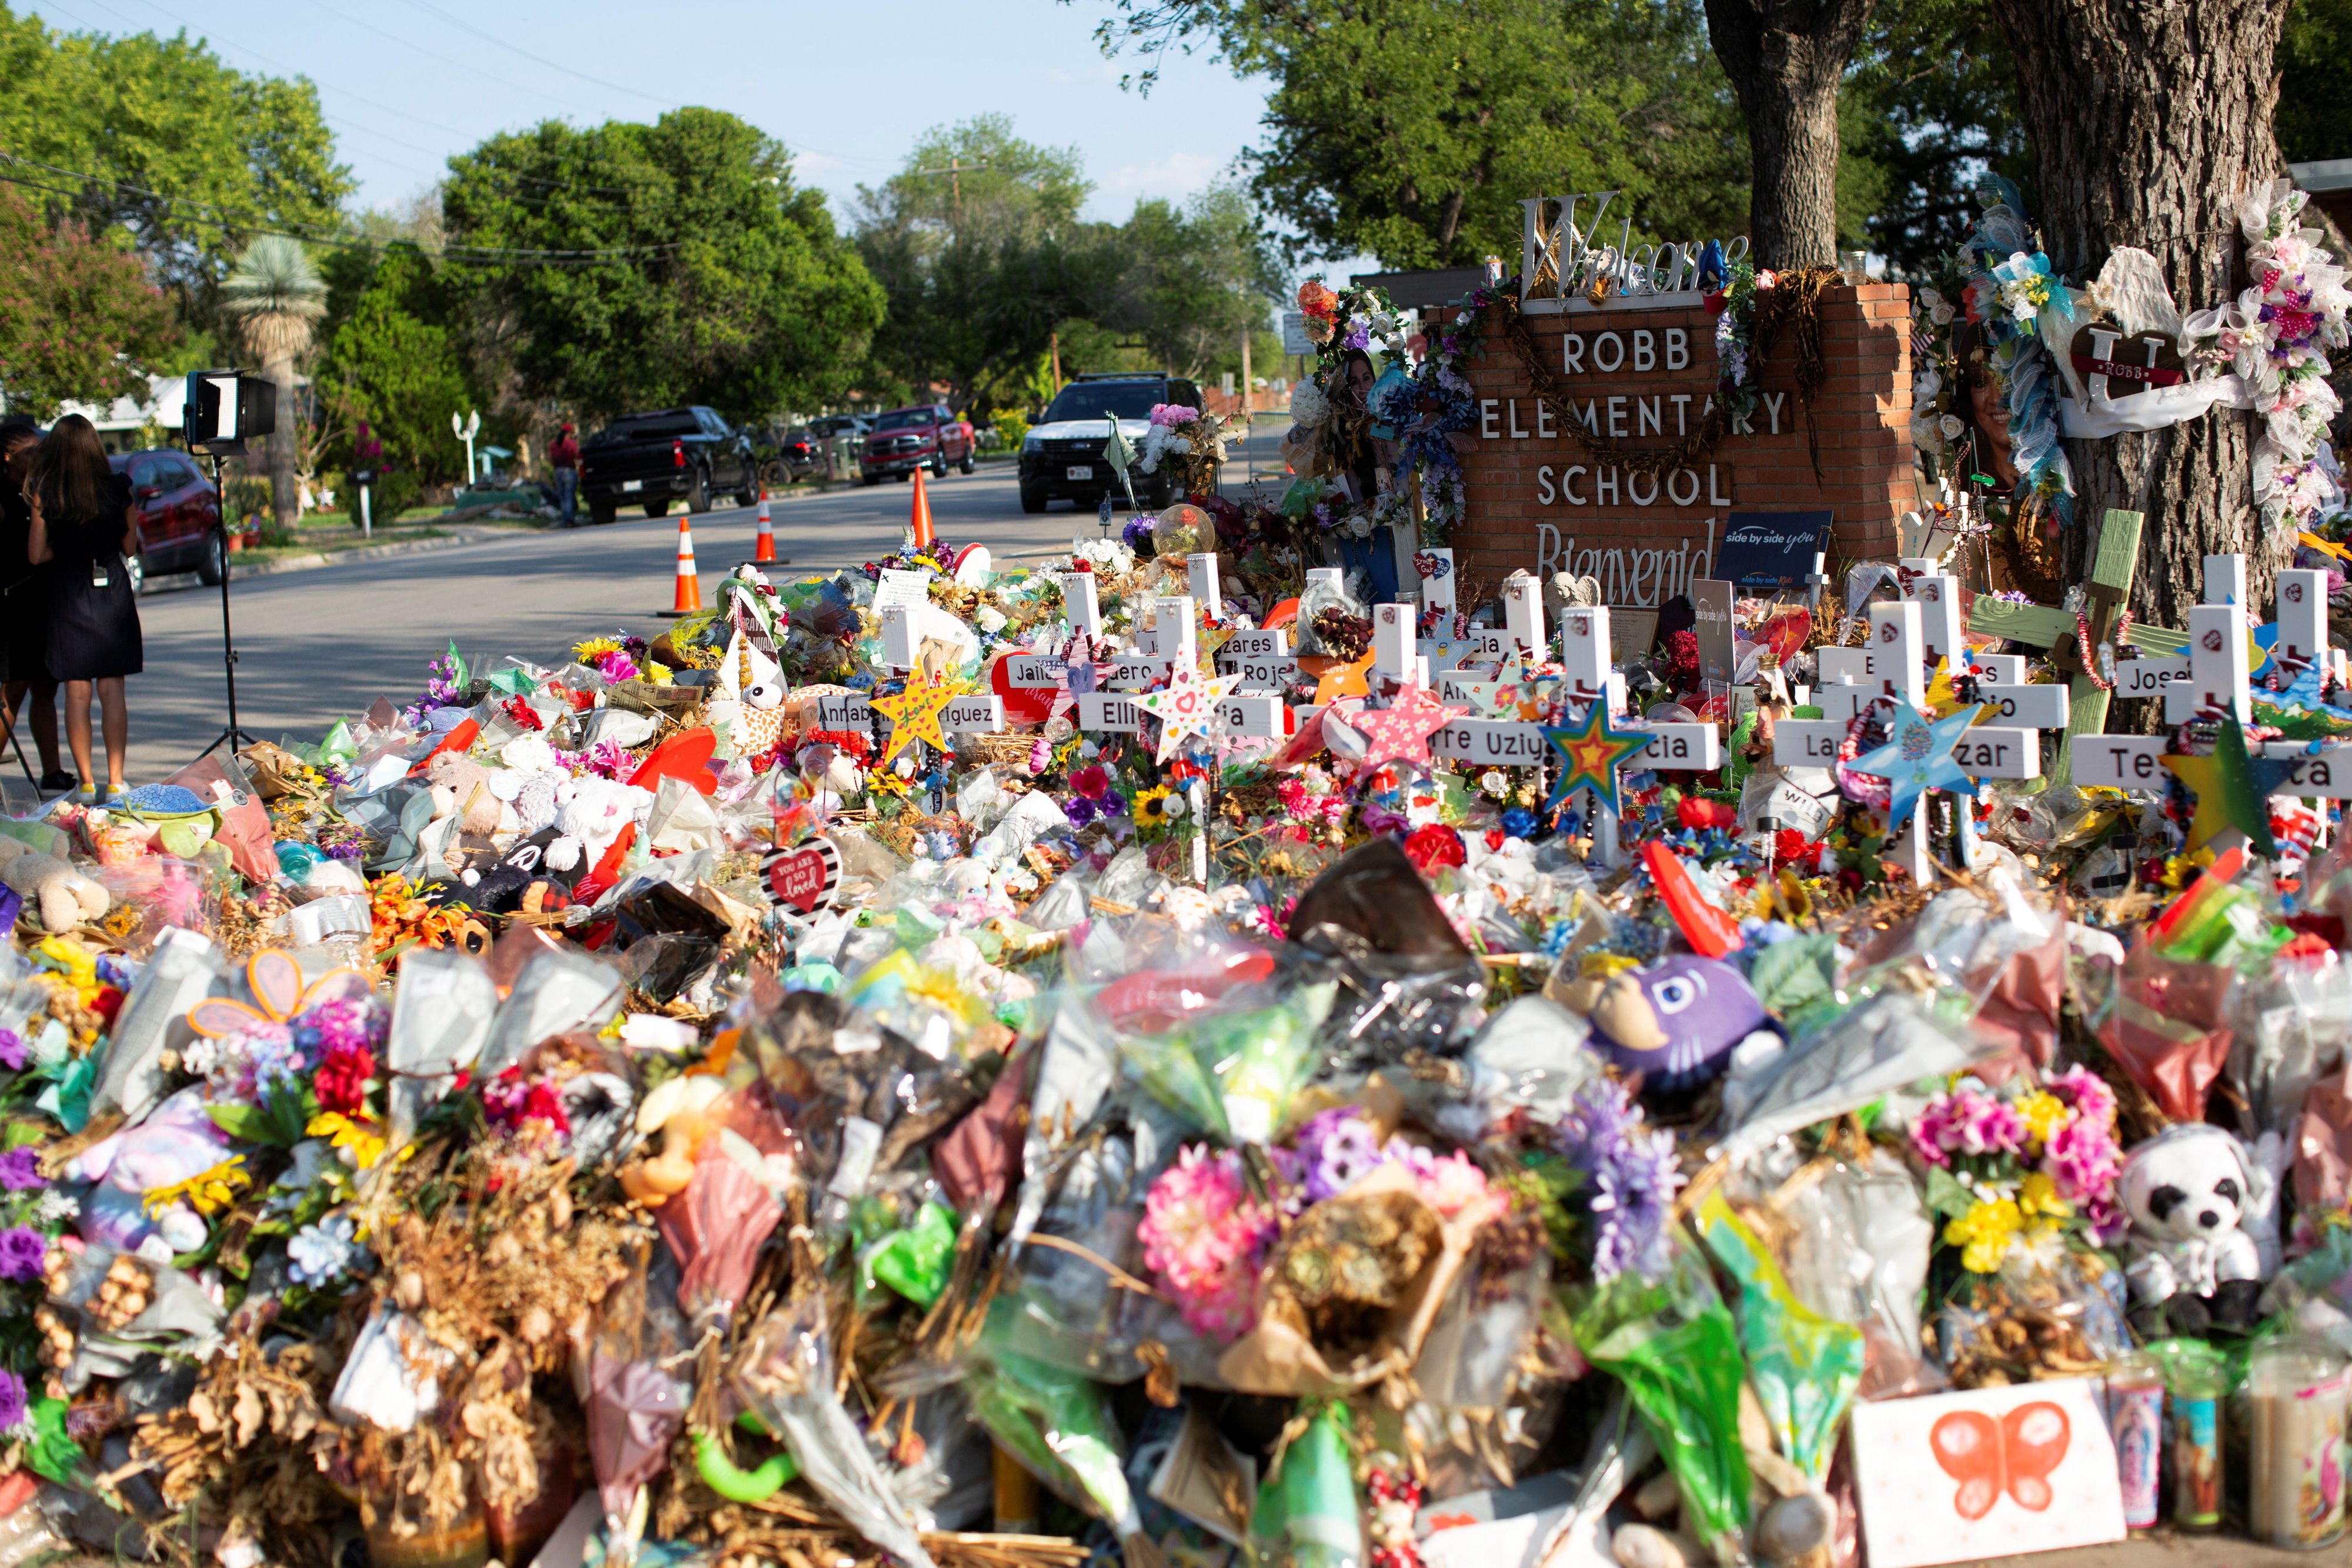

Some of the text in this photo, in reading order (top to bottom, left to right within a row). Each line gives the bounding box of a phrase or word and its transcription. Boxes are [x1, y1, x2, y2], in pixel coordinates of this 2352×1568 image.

[1516, 190, 1748, 301] Welcome
[1564, 329, 1689, 375] ROBB
[2104, 362, 2142, 379] ROBB
[1538, 464, 1730, 507] SCHOOL
[1726, 530, 1816, 554] side by side you
[1536, 517, 1716, 608] Bienvenid
[1741, 575, 1755, 583] side
[1765, 574, 1778, 583] side
[1778, 576, 1793, 586] Kids
[1222, 638, 1271, 654] zares
[1324, 664, 1351, 674] LOVED
[819, 705, 890, 722] Annab
[899, 697, 931, 727] Love
[1103, 702, 1136, 724] Elli
[1221, 704, 1244, 727] ia
[1486, 731, 1543, 761] Uziy
[1645, 735, 1689, 759] cia
[1956, 743, 2010, 767] zar
[777, 855, 814, 877] YOU ARE
[793, 871, 806, 882] SO
[784, 866, 819, 898] loved
